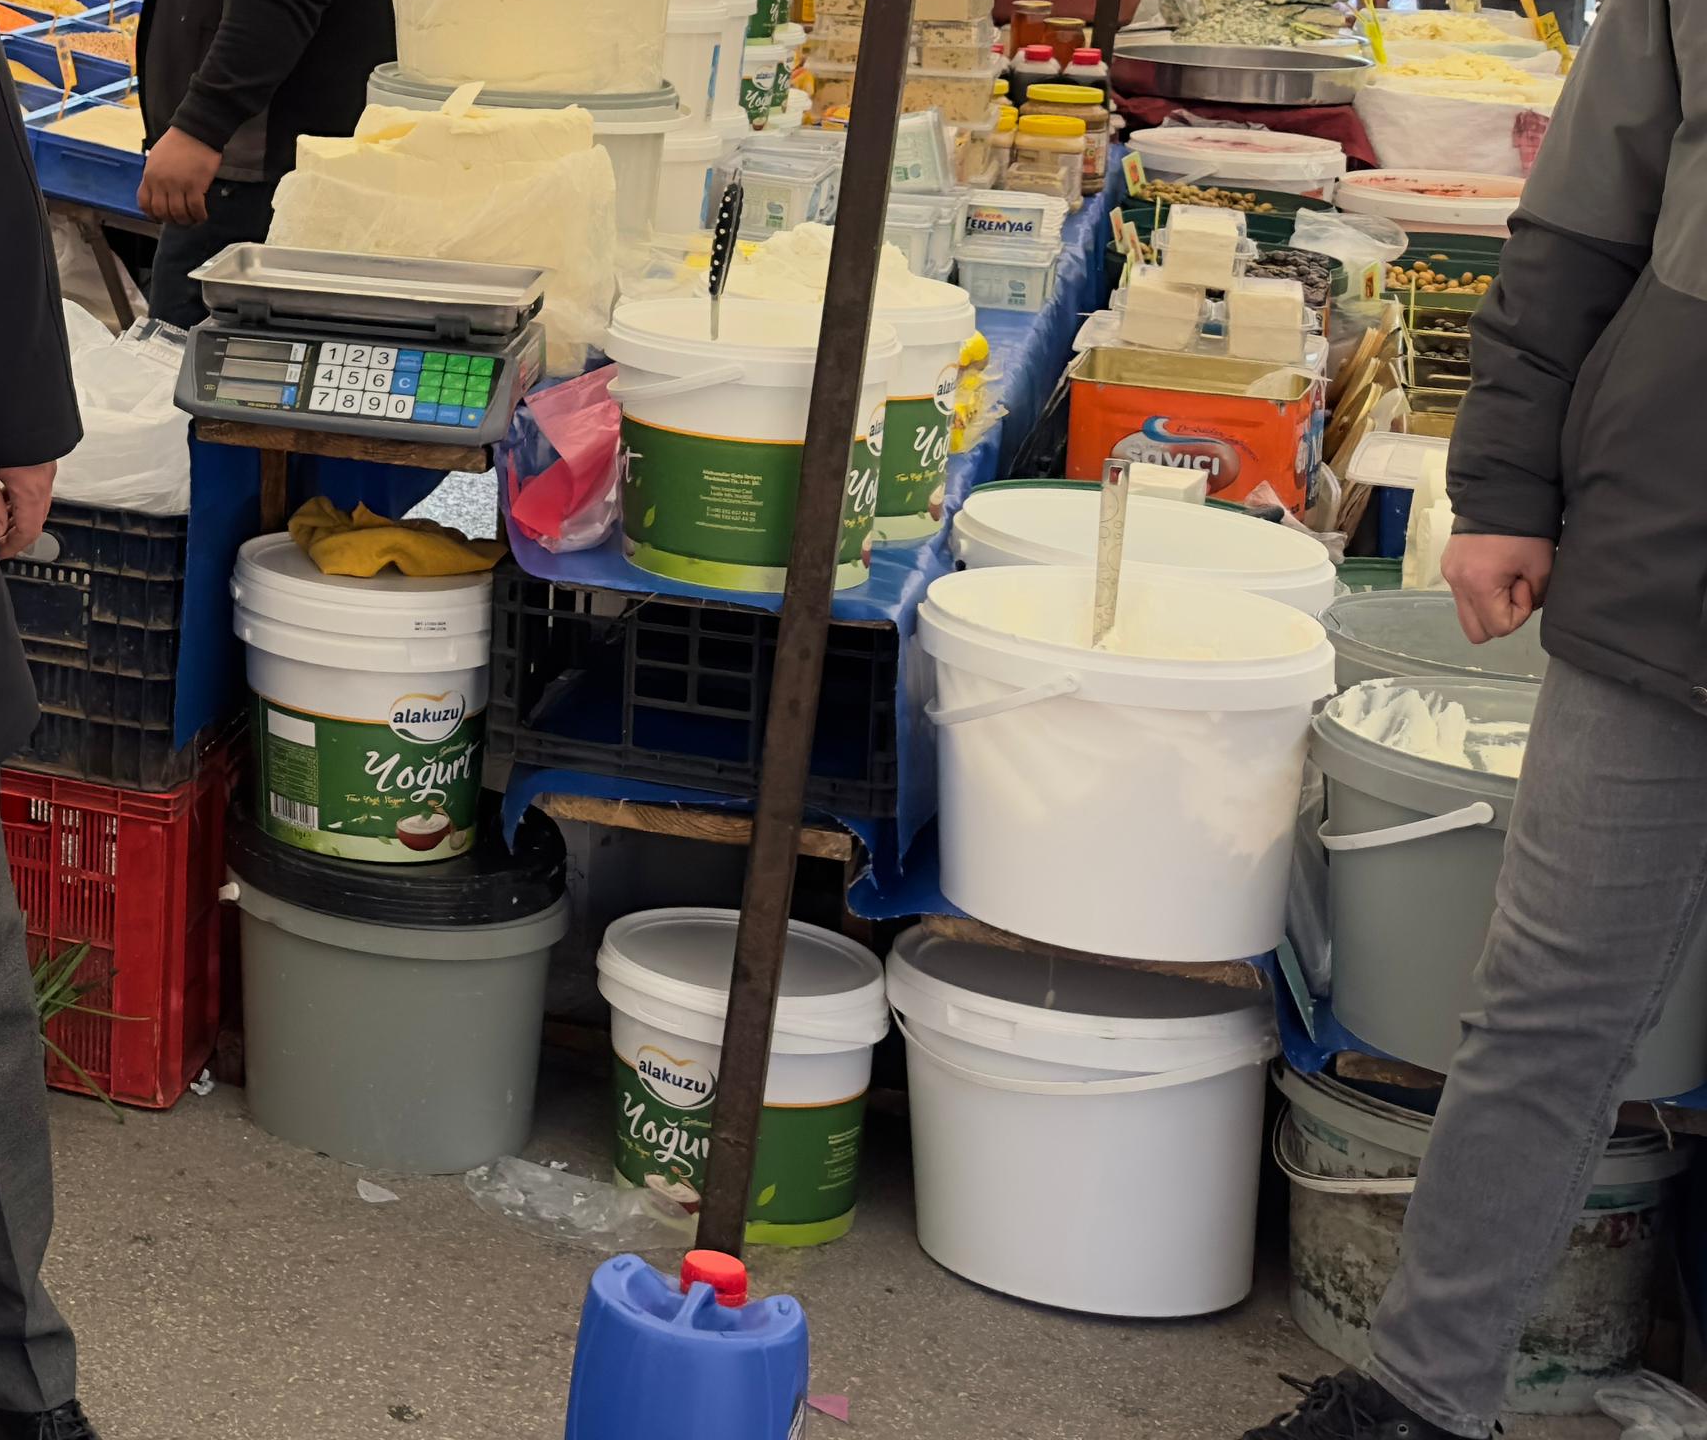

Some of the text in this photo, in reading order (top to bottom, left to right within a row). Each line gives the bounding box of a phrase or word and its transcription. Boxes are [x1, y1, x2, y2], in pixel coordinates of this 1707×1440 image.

[352, 350, 365, 362] 2
[377, 352, 390, 365] 3
[321, 370, 334, 382] 4
[347, 371, 360, 385] 5
[372, 374, 385, 387] 6
[318, 392, 406, 413] 7 8 9 0
[392, 707, 460, 724] alakuzu
[364, 740, 481, 808] Yoğurt
[638, 1059, 707, 1095] alakuzu
[623, 1092, 709, 1178] Yoğu
